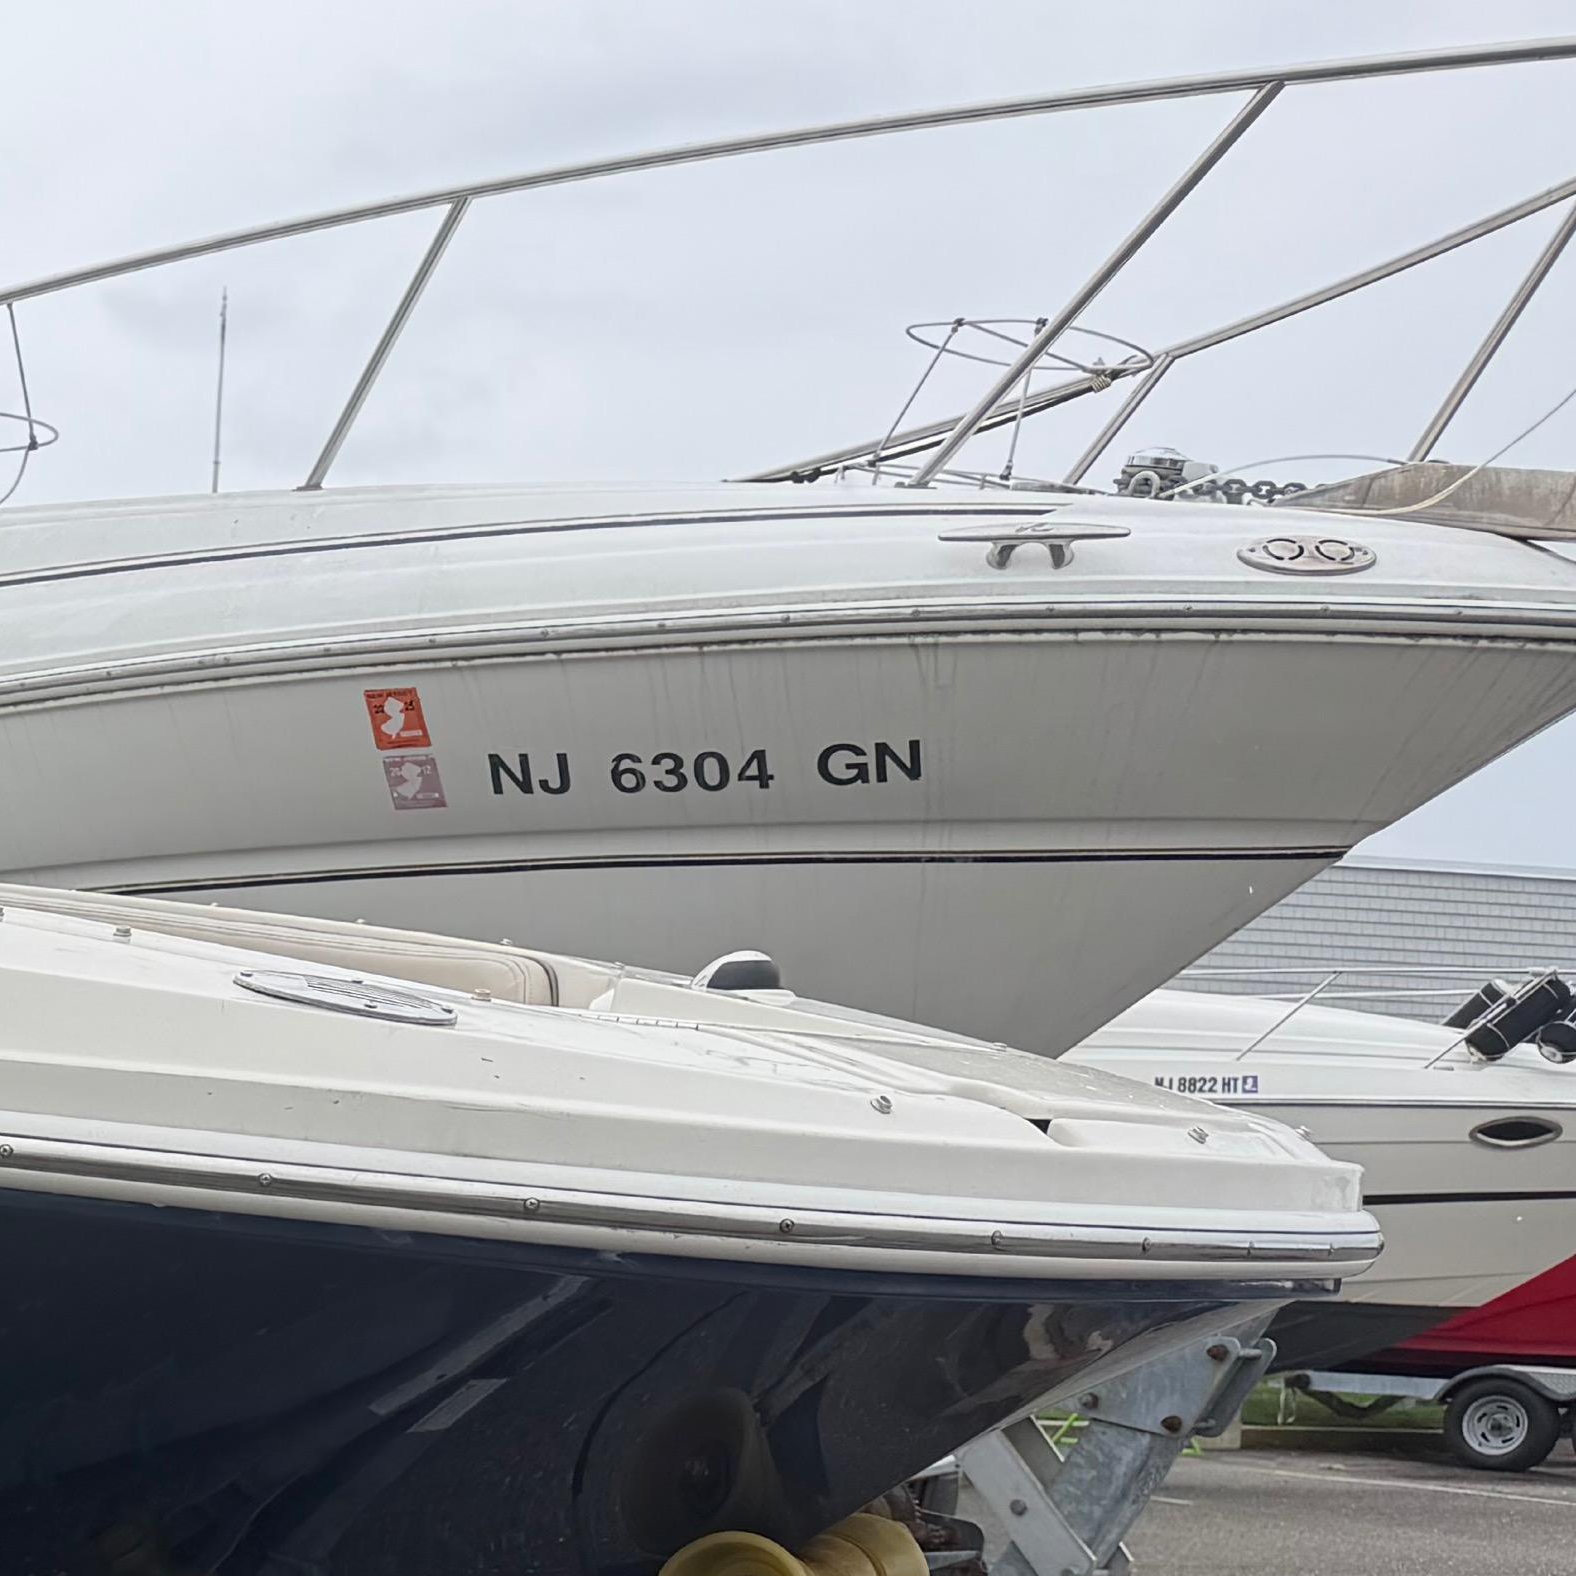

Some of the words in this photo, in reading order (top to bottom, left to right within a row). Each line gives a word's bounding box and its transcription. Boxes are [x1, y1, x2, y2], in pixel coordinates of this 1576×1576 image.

[488, 753, 571, 796] NJ
[610, 749, 774, 794] 6304
[816, 740, 922, 786] GN
[1177, 1077, 1218, 1093] 8822
[1222, 1077, 1239, 1093] HT
